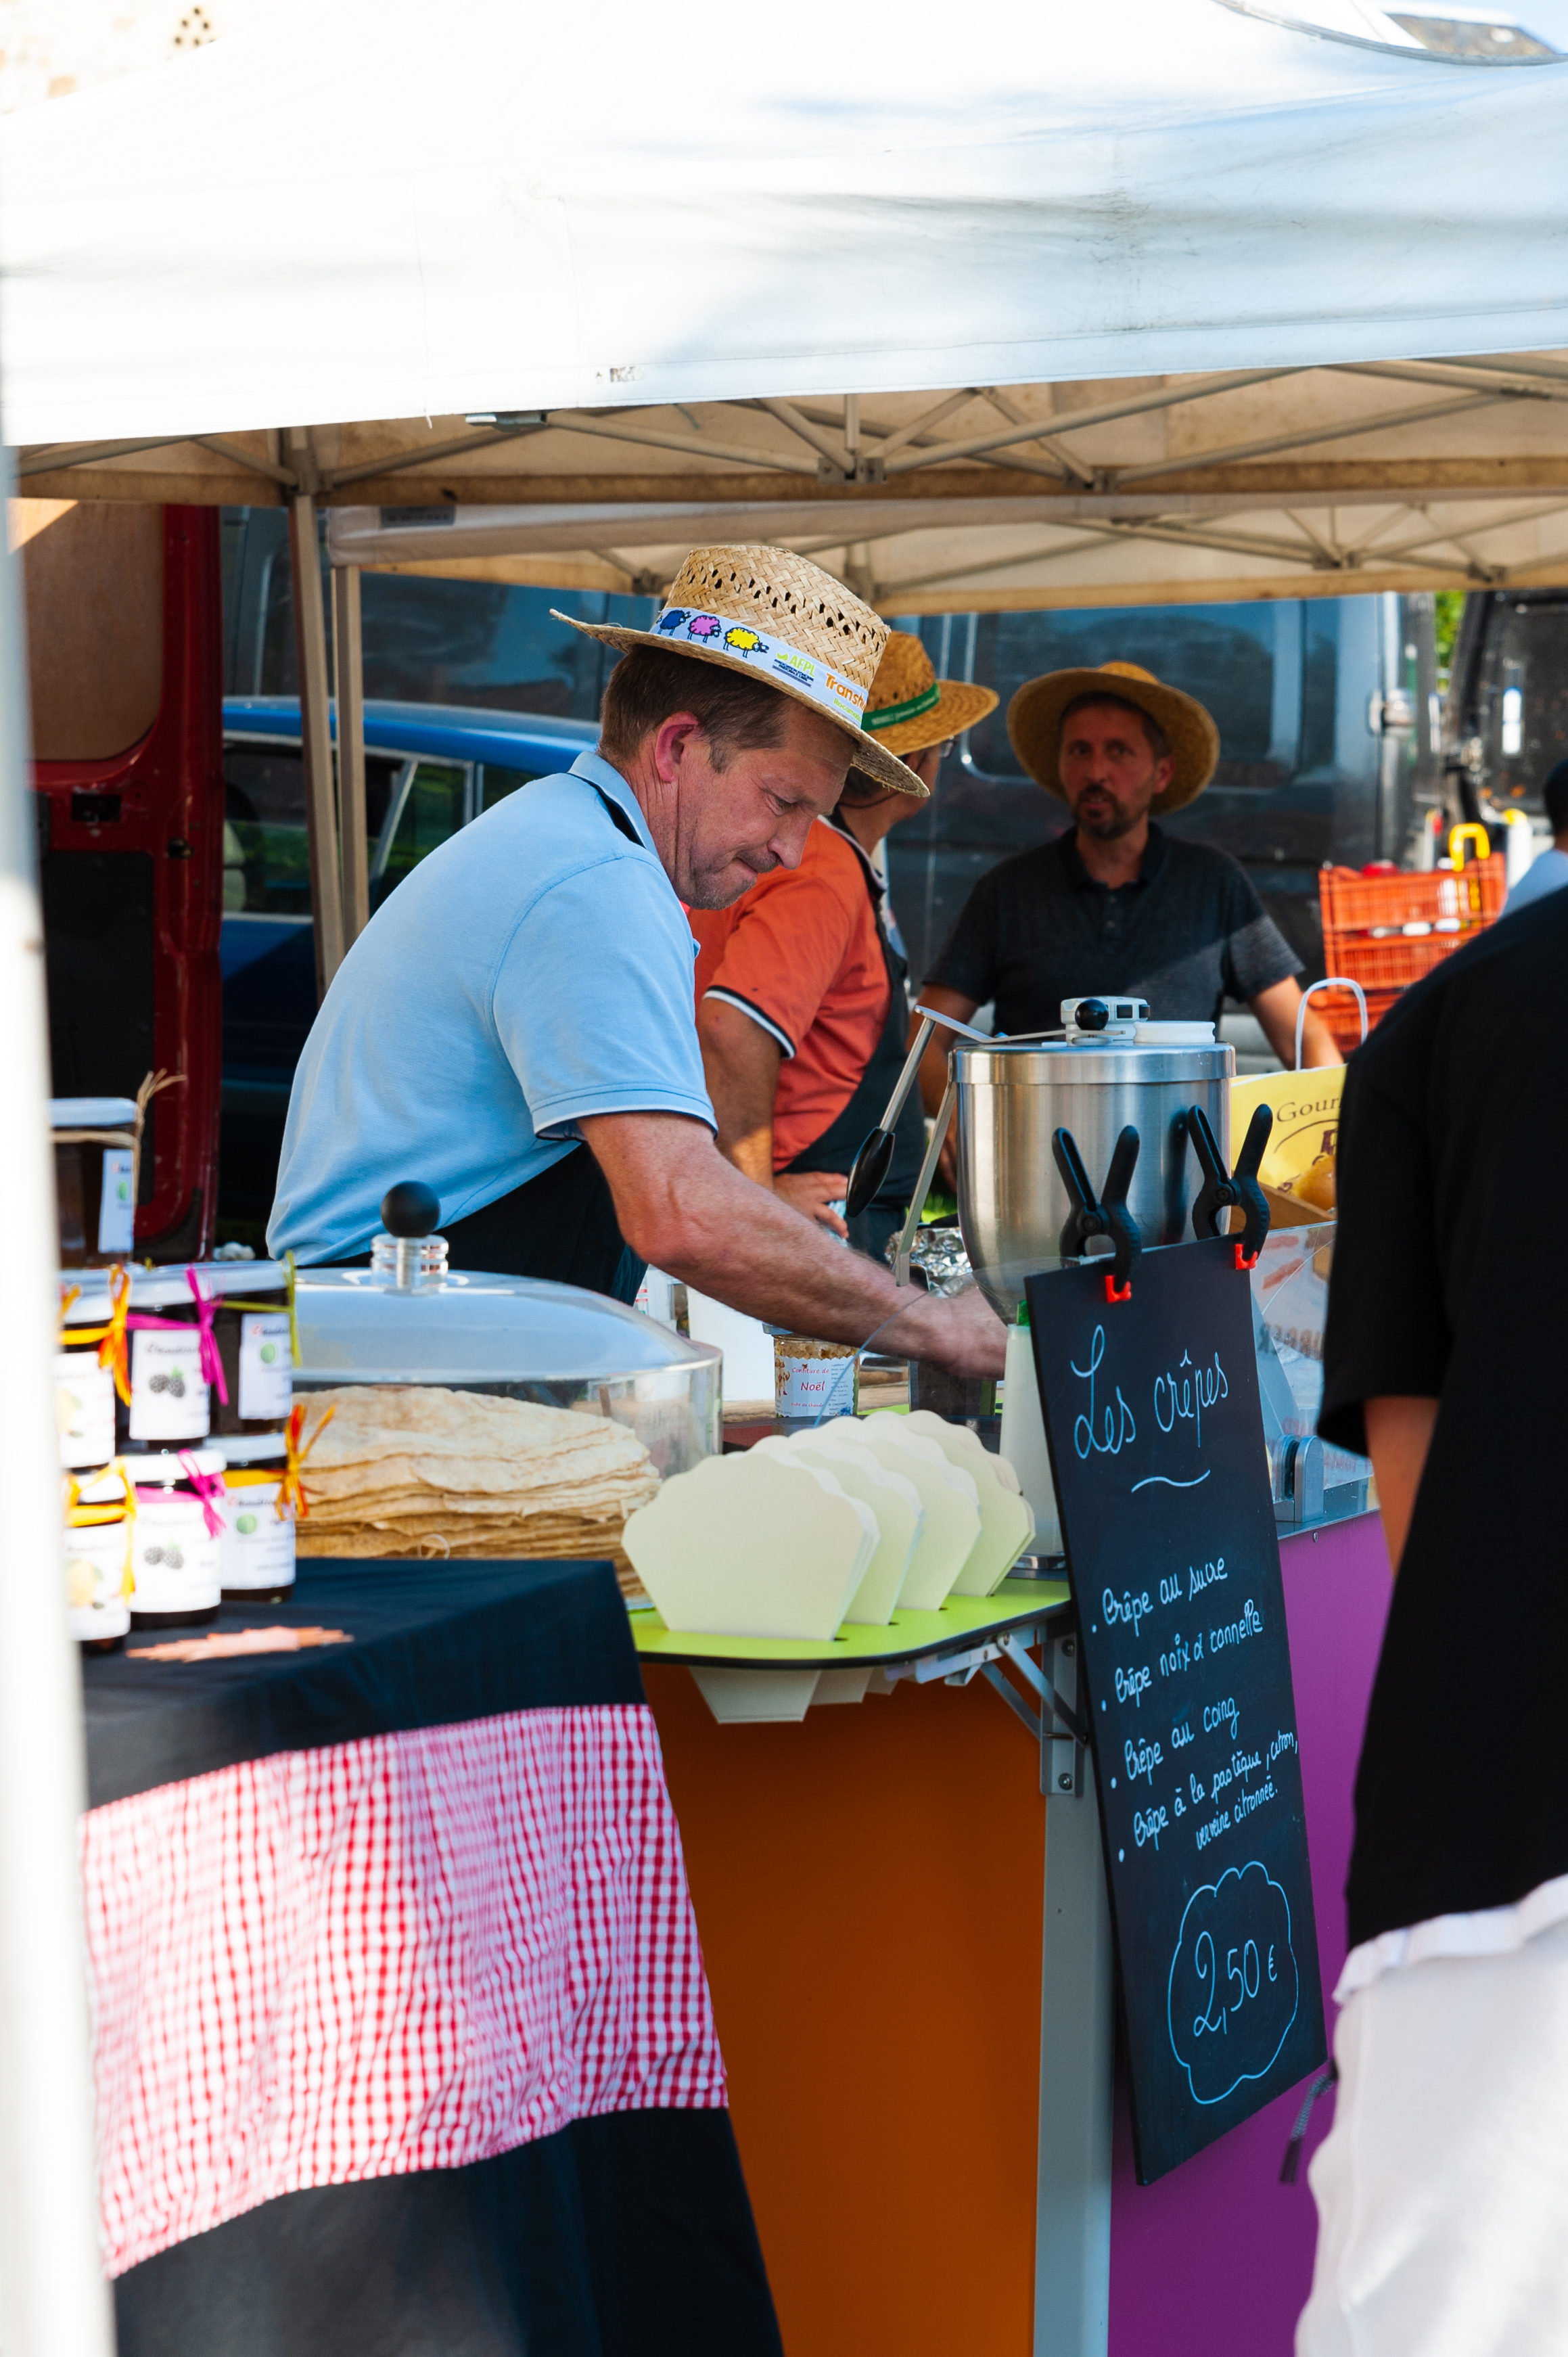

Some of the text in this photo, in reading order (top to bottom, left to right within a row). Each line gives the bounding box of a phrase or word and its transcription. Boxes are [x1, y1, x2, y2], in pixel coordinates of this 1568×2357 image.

[789, 655, 815, 677] AFPL
[801, 1381, 825, 1391] Noël
[1071, 1325, 1228, 1459] Les crêpes
[1103, 1557, 1228, 1637] Crêpe au sucre
[1115, 1666, 1152, 1708] Crêpe
[1160, 1633, 1191, 1676] noix
[1210, 1599, 1263, 1653] cannelle
[1125, 1697, 1239, 1785] Crêpe au coing
[1134, 1806, 1169, 1850] Crêpe
[1174, 1787, 1186, 1816] à
[1190, 1773, 1205, 1804] la
[1194, 1931, 1277, 2036] 2,50 €
